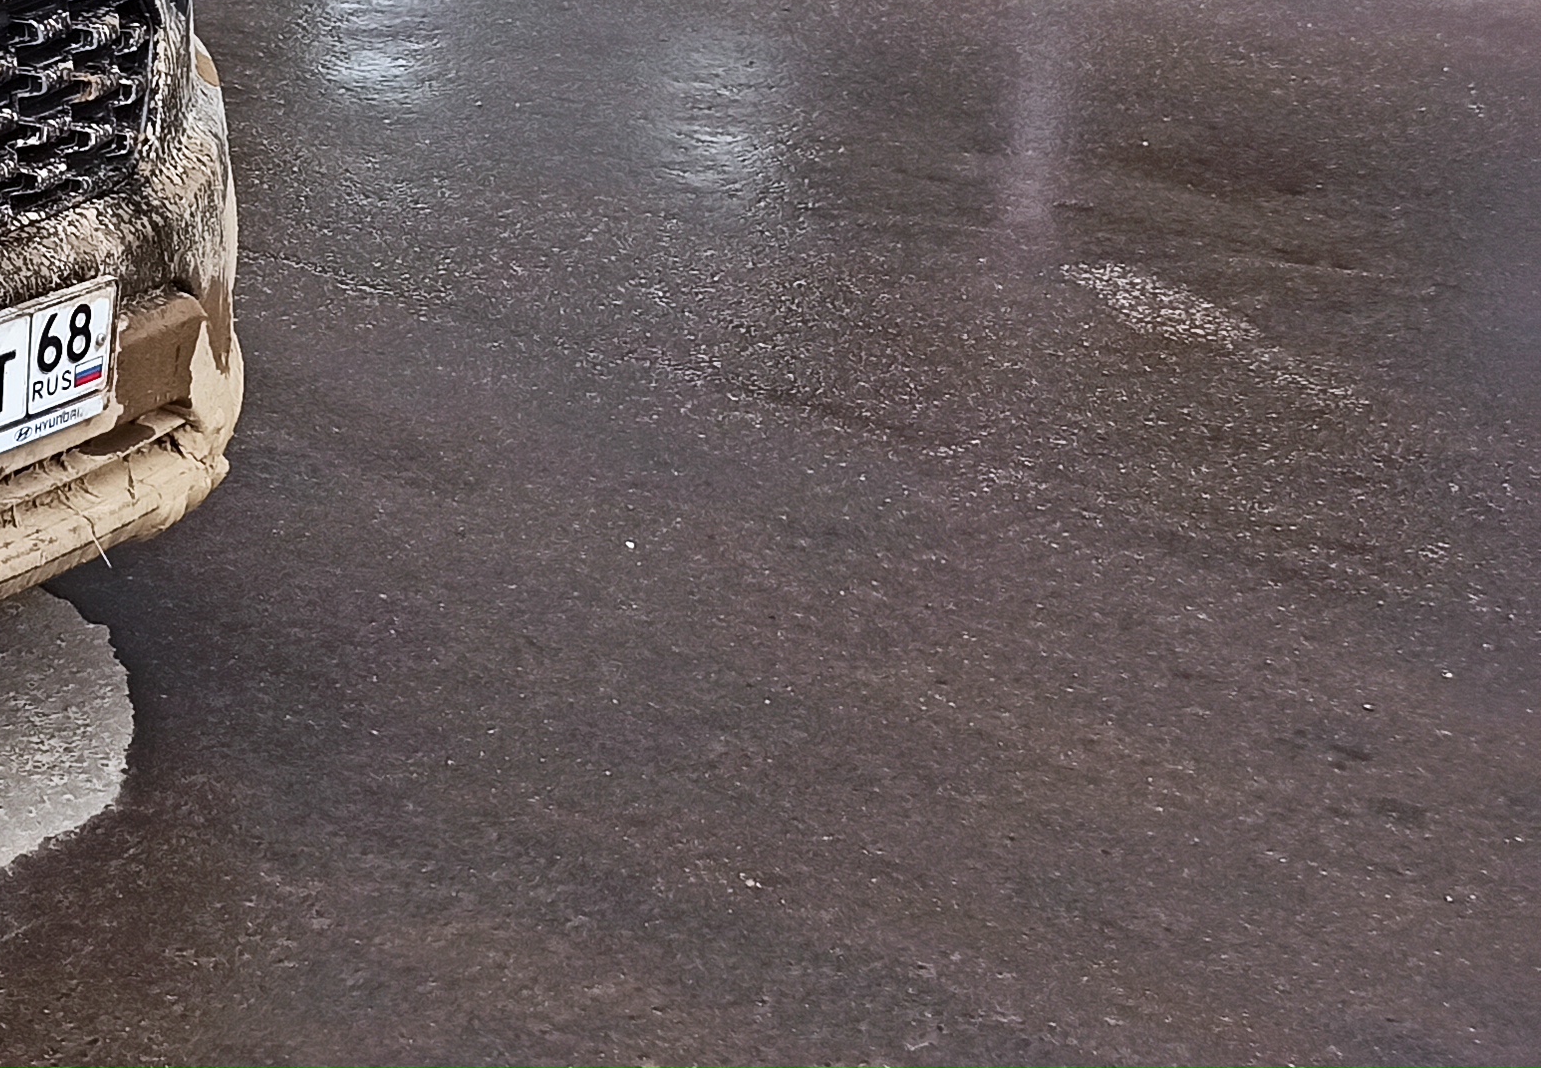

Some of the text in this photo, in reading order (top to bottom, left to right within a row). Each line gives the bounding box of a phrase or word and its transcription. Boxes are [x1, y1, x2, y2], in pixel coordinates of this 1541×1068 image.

[36, 303, 92, 373] 68
[32, 369, 72, 402] RUS
[34, 408, 80, 434] HYUNDAI
